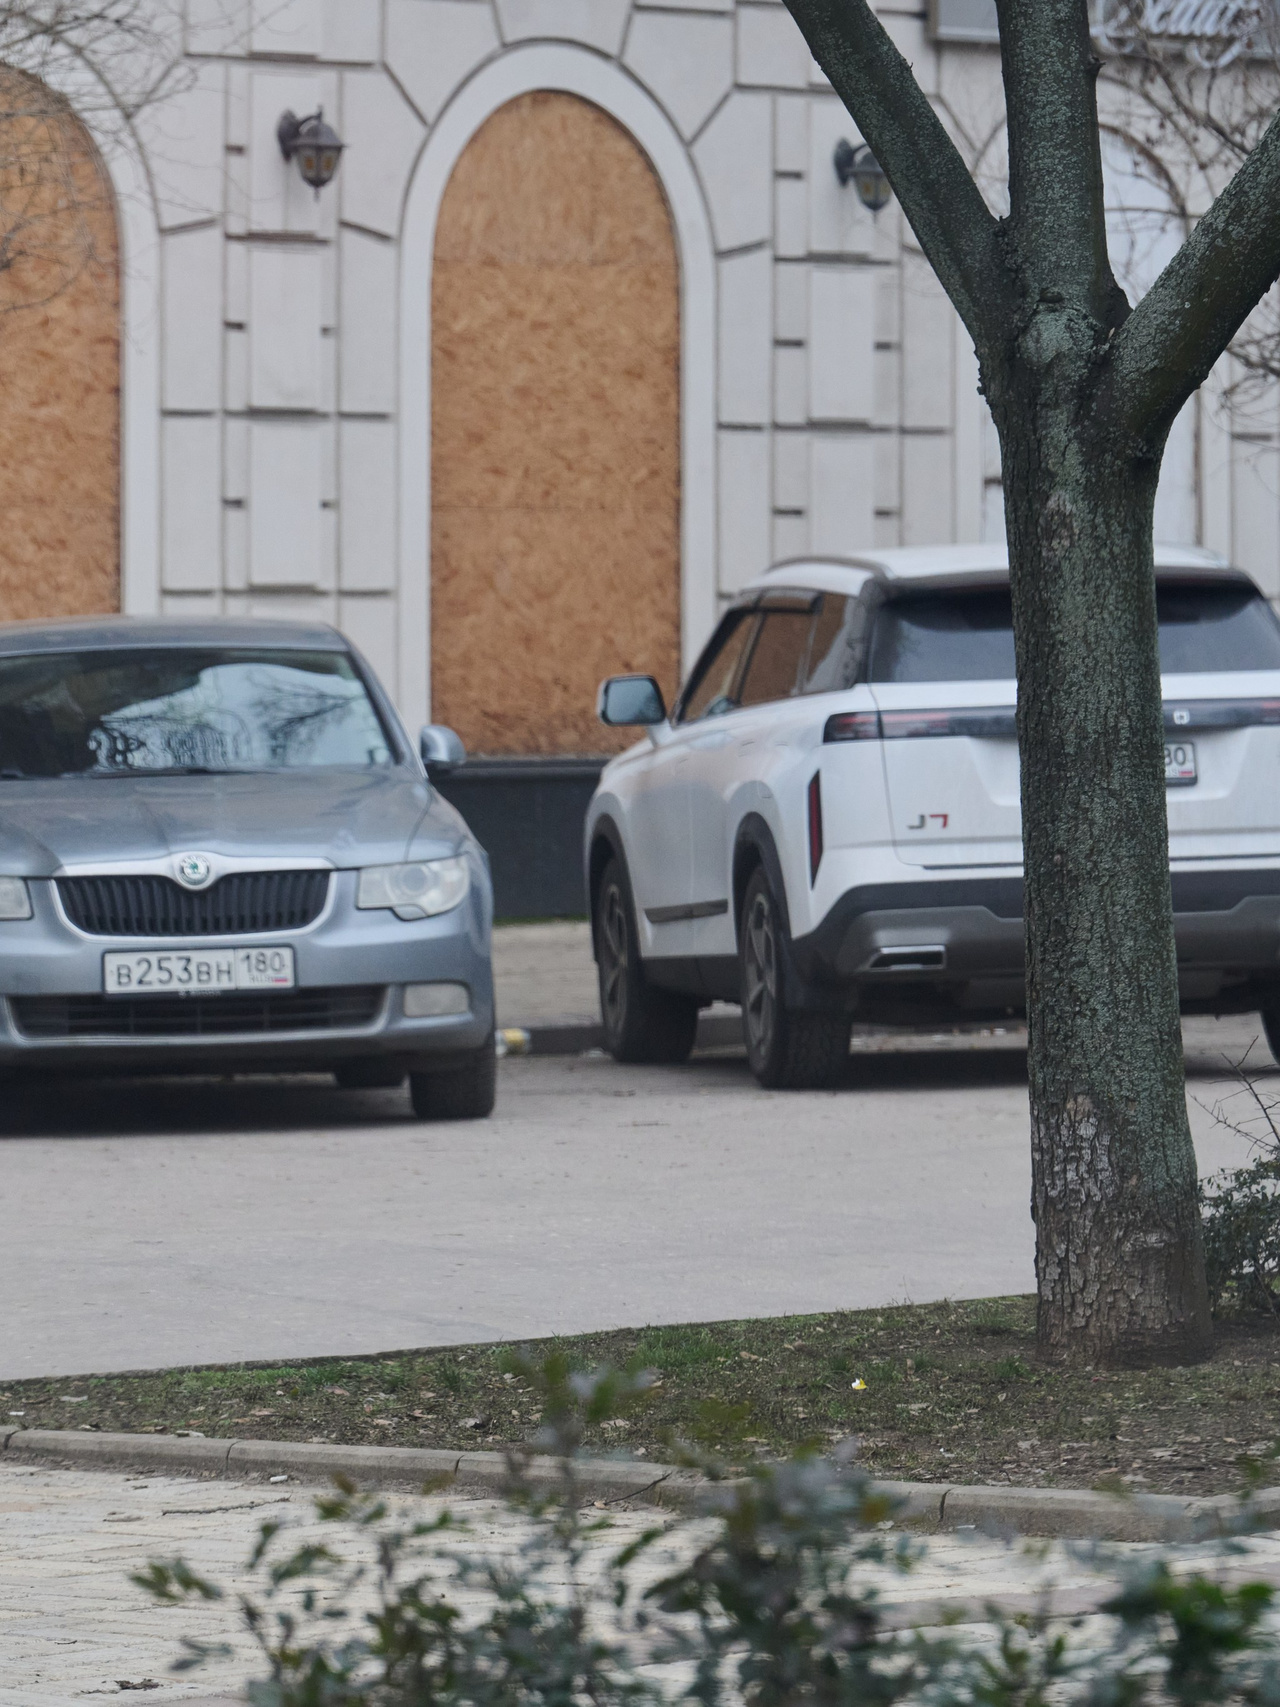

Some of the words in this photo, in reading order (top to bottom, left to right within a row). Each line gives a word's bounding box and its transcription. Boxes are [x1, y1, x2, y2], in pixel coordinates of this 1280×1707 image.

[1164, 747, 1186, 766] 80
[907, 814, 948, 830] J7
[240, 951, 285, 973] 180
